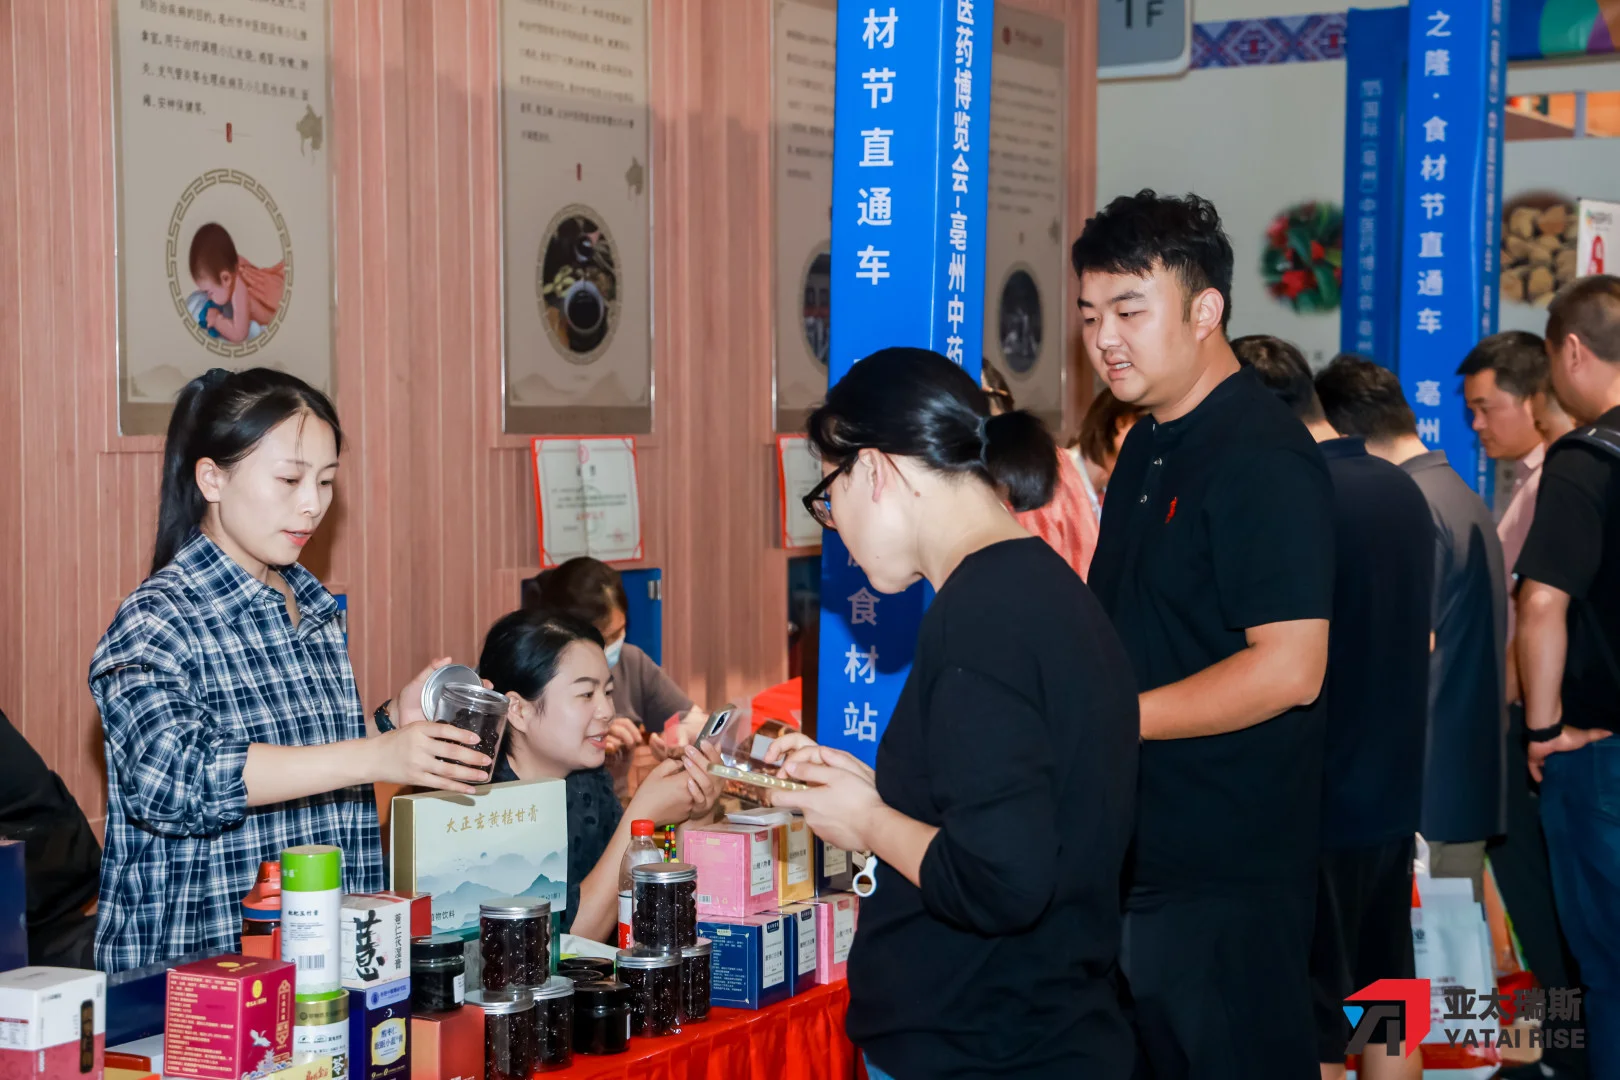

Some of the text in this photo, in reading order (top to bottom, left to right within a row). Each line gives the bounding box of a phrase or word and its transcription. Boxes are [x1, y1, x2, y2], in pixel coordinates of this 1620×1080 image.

[1116, 0, 1164, 29] 1F
[855, 7, 899, 286] 材节直通车
[843, 548, 880, 742] 食材站
